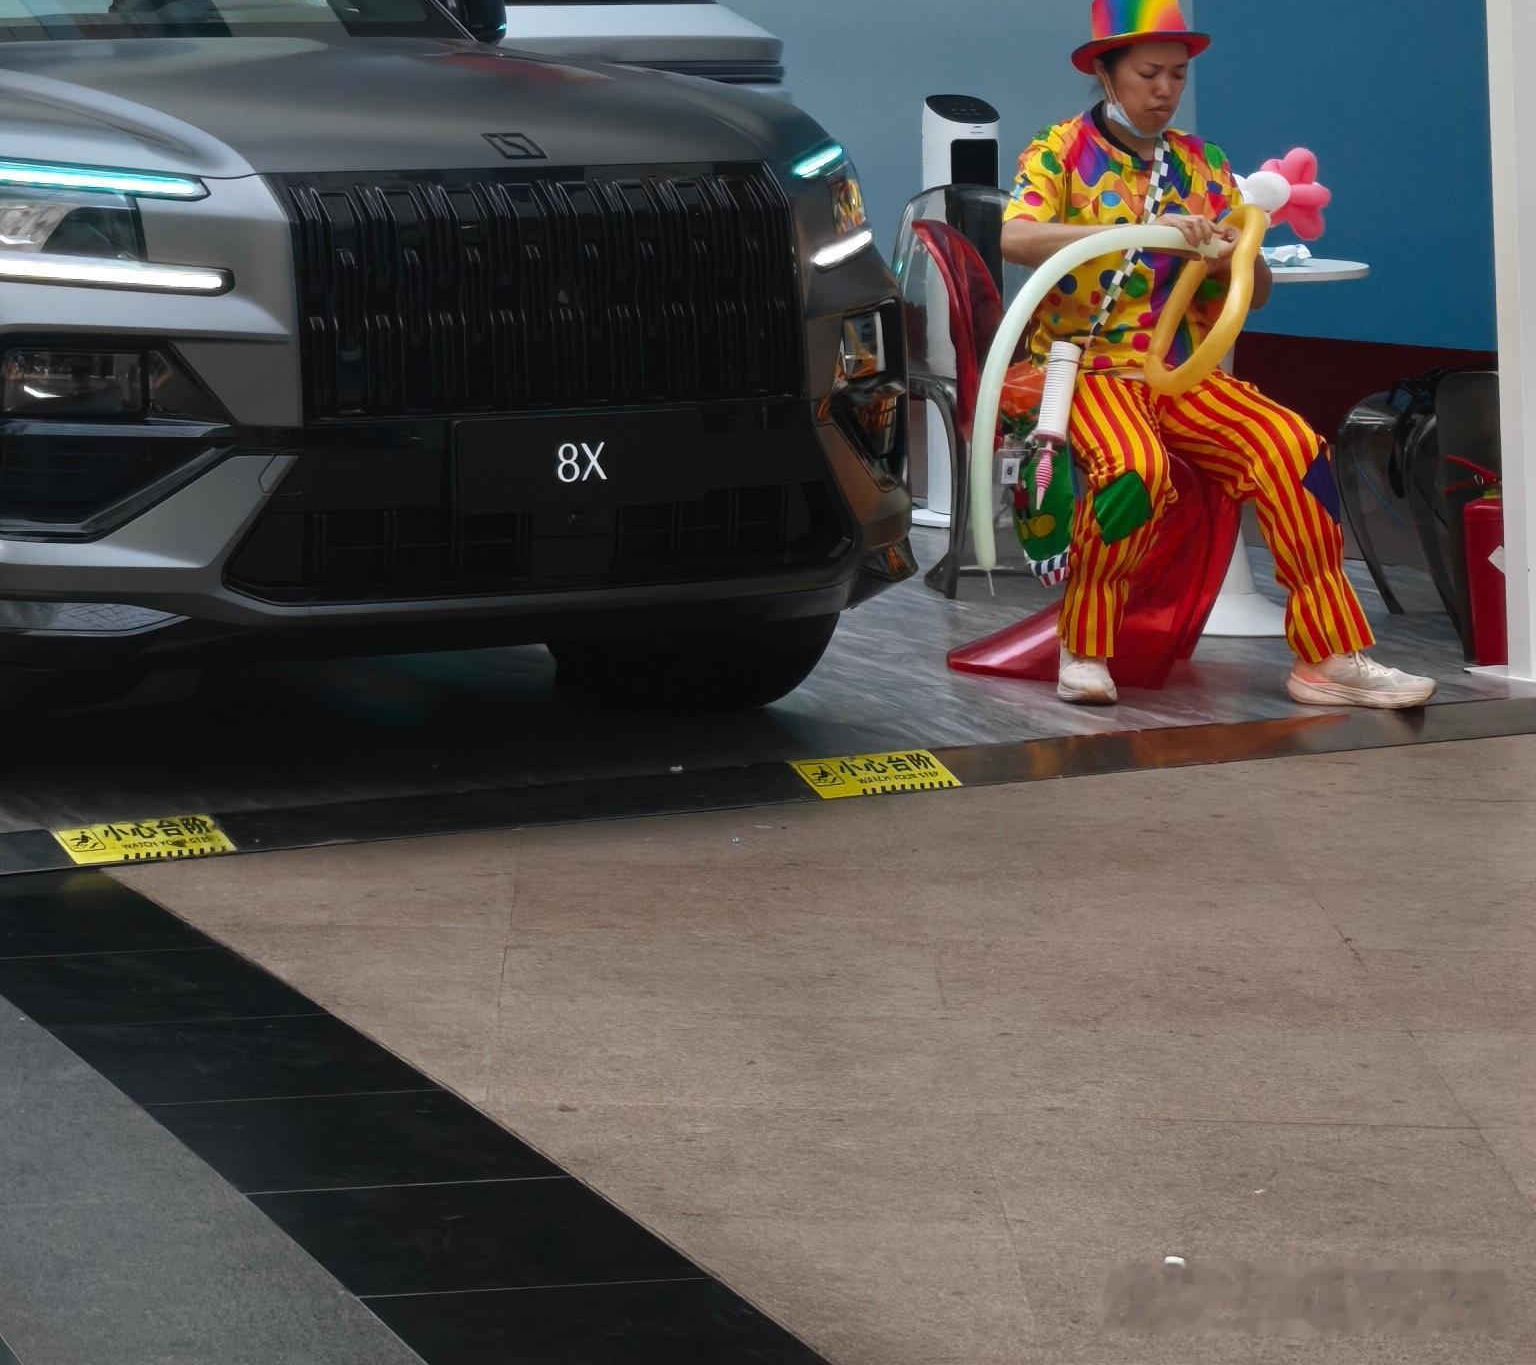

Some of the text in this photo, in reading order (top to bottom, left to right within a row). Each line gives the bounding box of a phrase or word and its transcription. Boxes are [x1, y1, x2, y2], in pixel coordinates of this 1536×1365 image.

[557, 441, 608, 483] 8X
[839, 753, 937, 777] 小心台阶
[103, 817, 214, 842] 小心台阶
